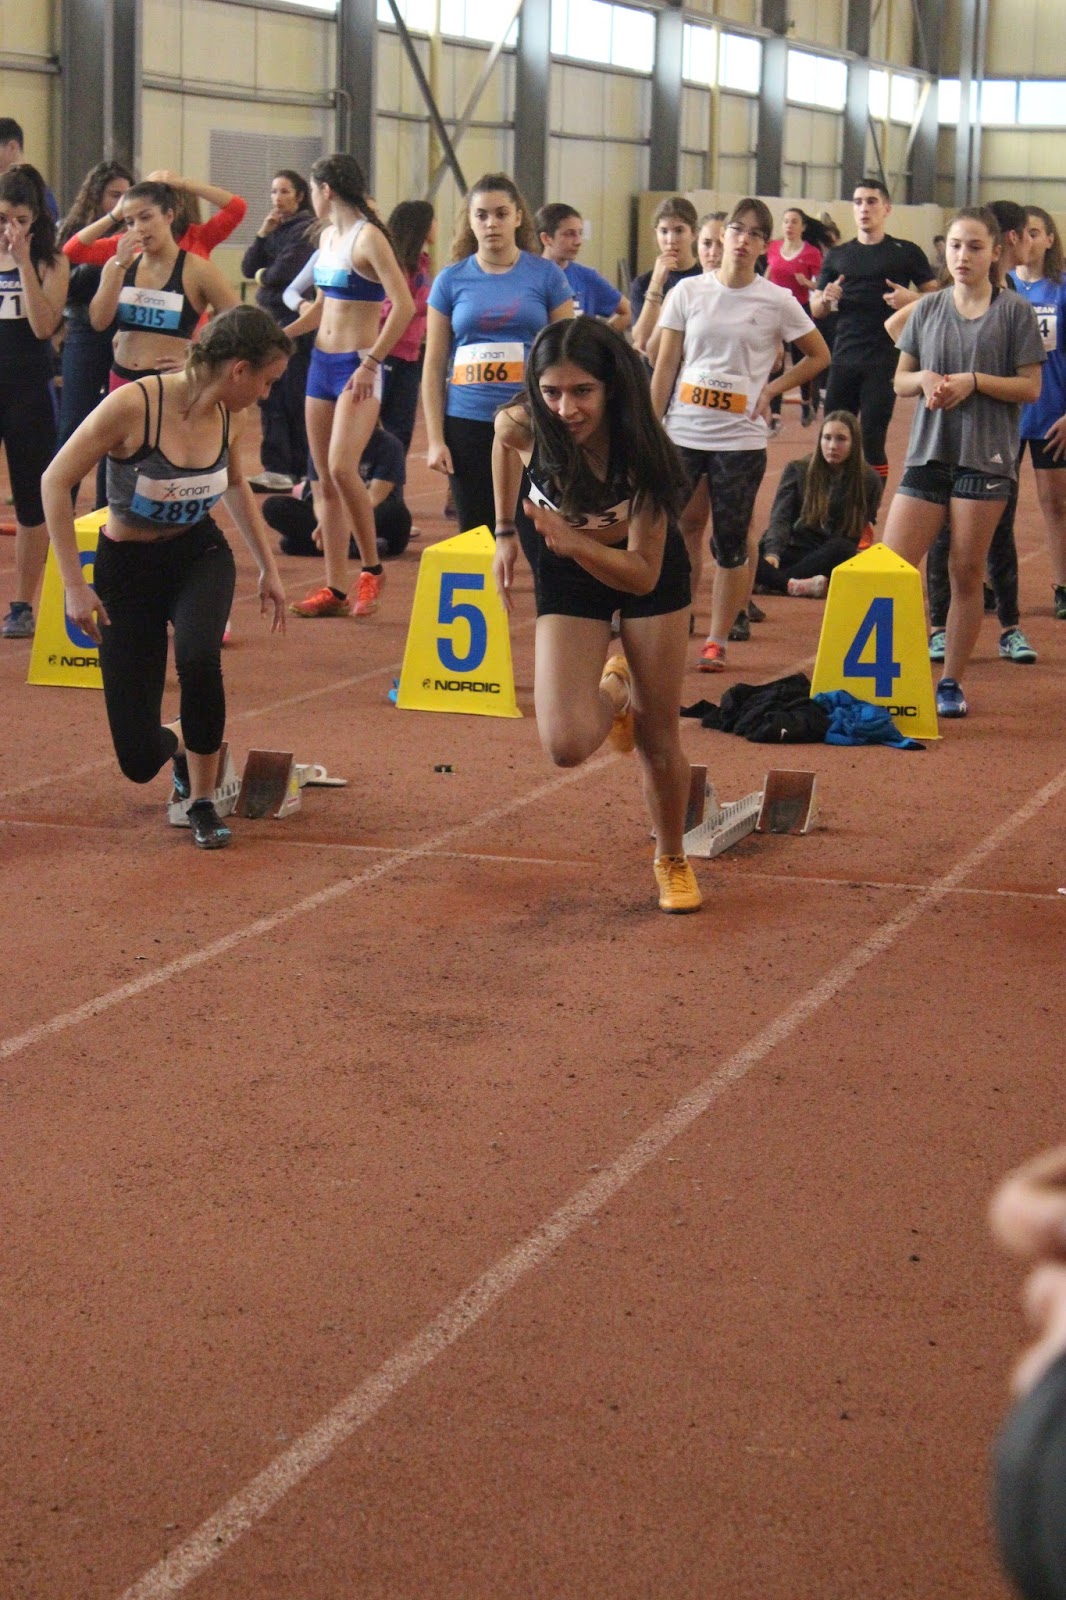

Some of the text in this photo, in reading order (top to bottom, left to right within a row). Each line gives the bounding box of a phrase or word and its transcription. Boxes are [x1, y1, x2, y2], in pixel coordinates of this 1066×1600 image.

[128, 304, 165, 326] 3315
[1039, 318, 1050, 338] 4
[465, 362, 508, 382] 8166
[692, 386, 732, 410] 8135
[436, 572, 488, 672] 5
[843, 597, 901, 698] 4
[60, 656, 101, 667] NOR
[434, 680, 500, 694] NORDIC
[880, 705, 917, 717] DIC
